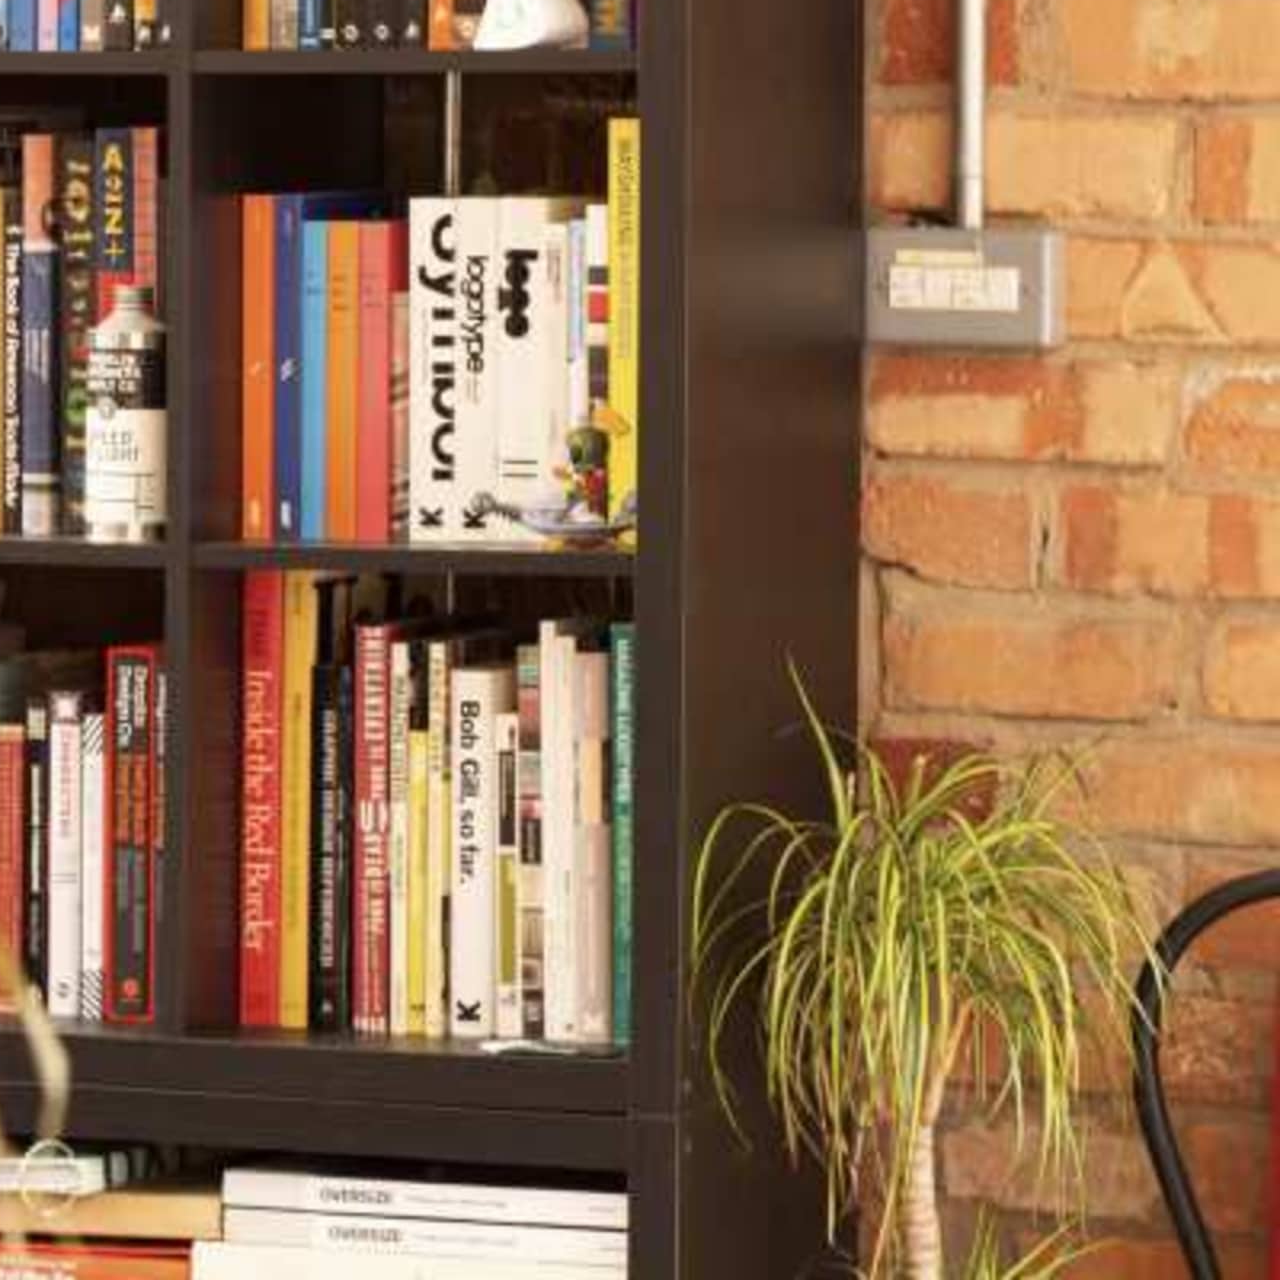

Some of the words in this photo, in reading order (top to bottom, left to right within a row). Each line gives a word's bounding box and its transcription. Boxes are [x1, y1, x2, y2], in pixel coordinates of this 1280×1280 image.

[459, 256, 489, 374] logotype
[245, 670, 273, 750] Inside
[460, 700, 481, 750] Bob
[245, 805, 273, 855] Red
[460, 810, 481, 840] so
[460, 844, 481, 885] far.
[244, 863, 272, 952] Border
